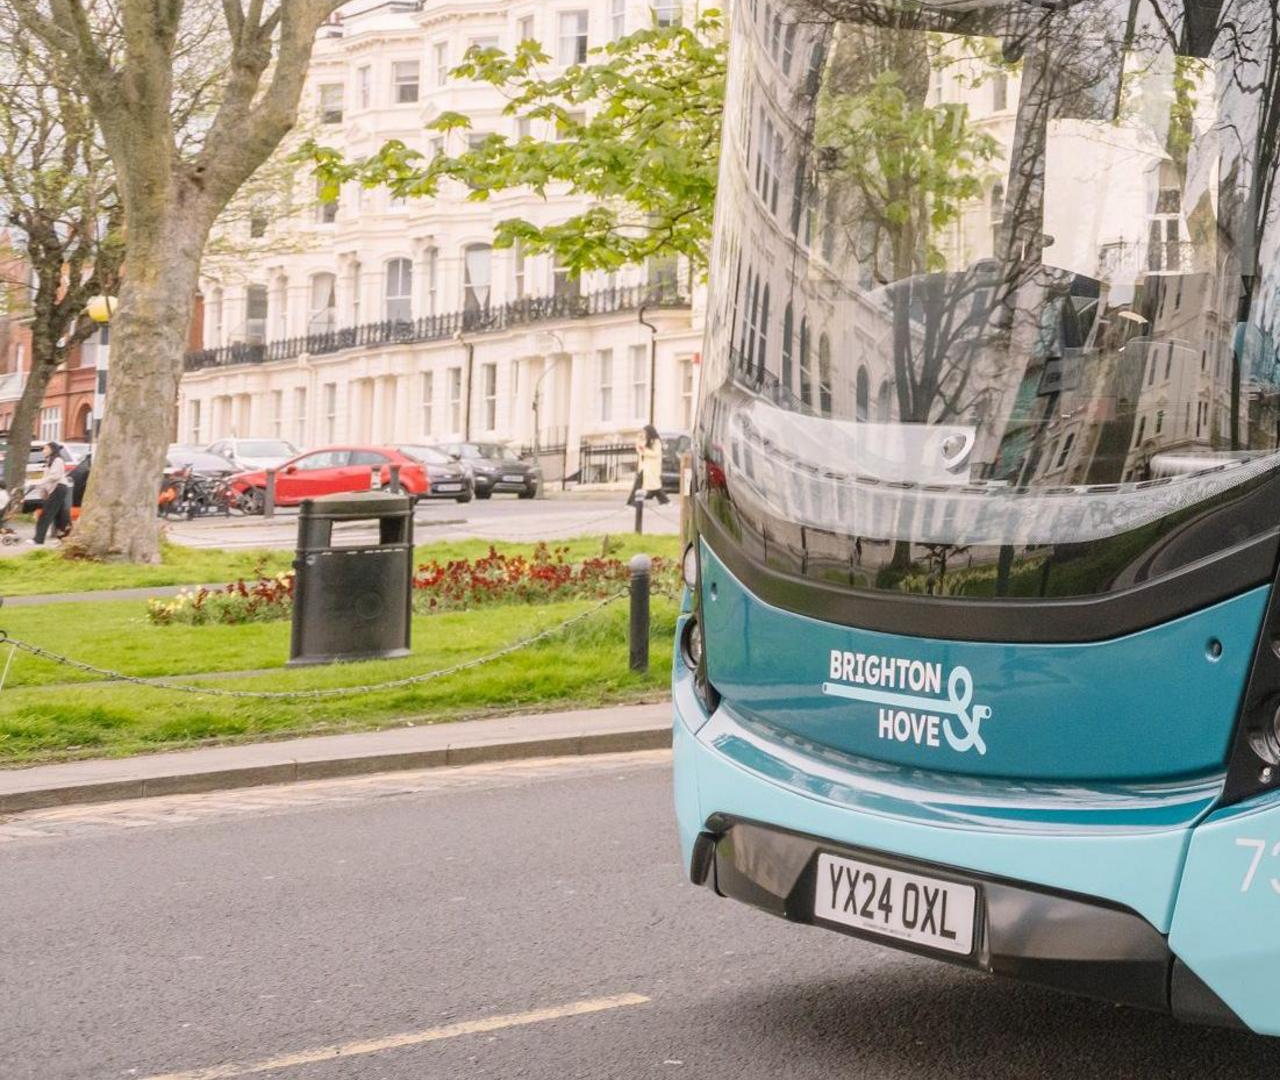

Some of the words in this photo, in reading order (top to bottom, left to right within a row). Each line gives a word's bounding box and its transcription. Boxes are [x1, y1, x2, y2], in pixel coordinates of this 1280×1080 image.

[829, 649, 942, 695] BRIGHTON
[878, 708, 940, 748] HOVE
[828, 863, 894, 925] YX24
[902, 886, 958, 941] OXL
